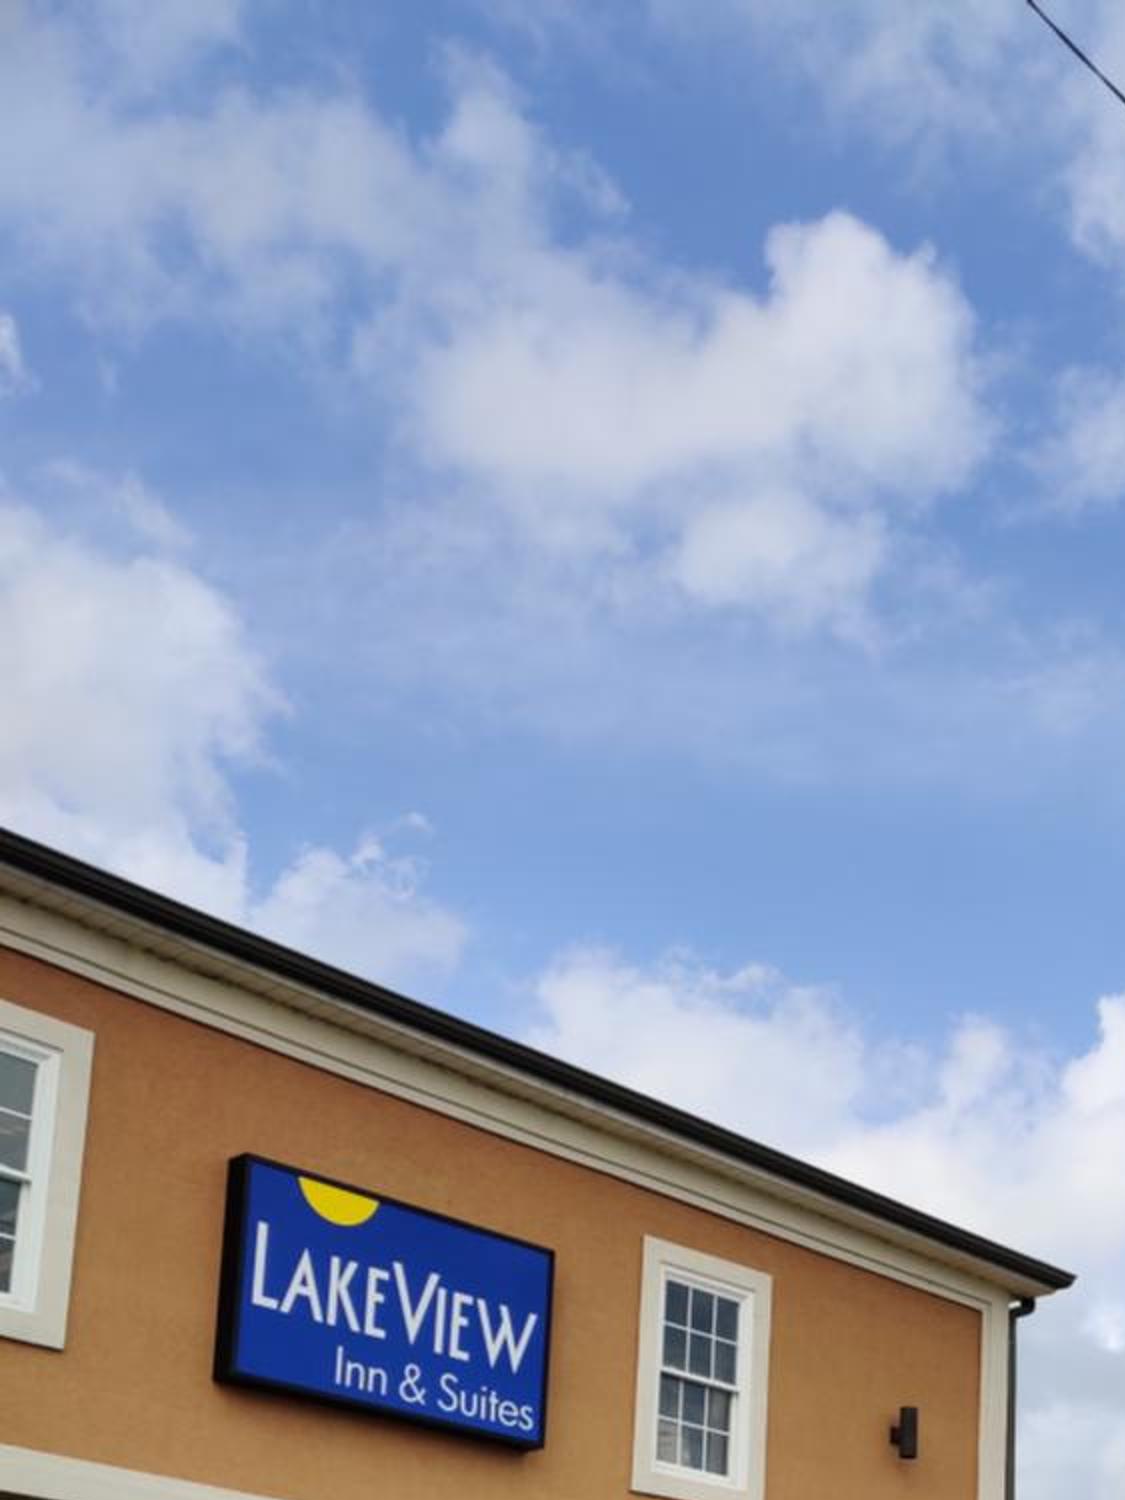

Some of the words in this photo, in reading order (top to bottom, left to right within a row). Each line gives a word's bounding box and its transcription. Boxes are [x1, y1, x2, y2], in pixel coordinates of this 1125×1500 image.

[334, 1345, 388, 1396] Inn
[399, 1363, 427, 1406] &
[437, 1372, 535, 1431] Suites
